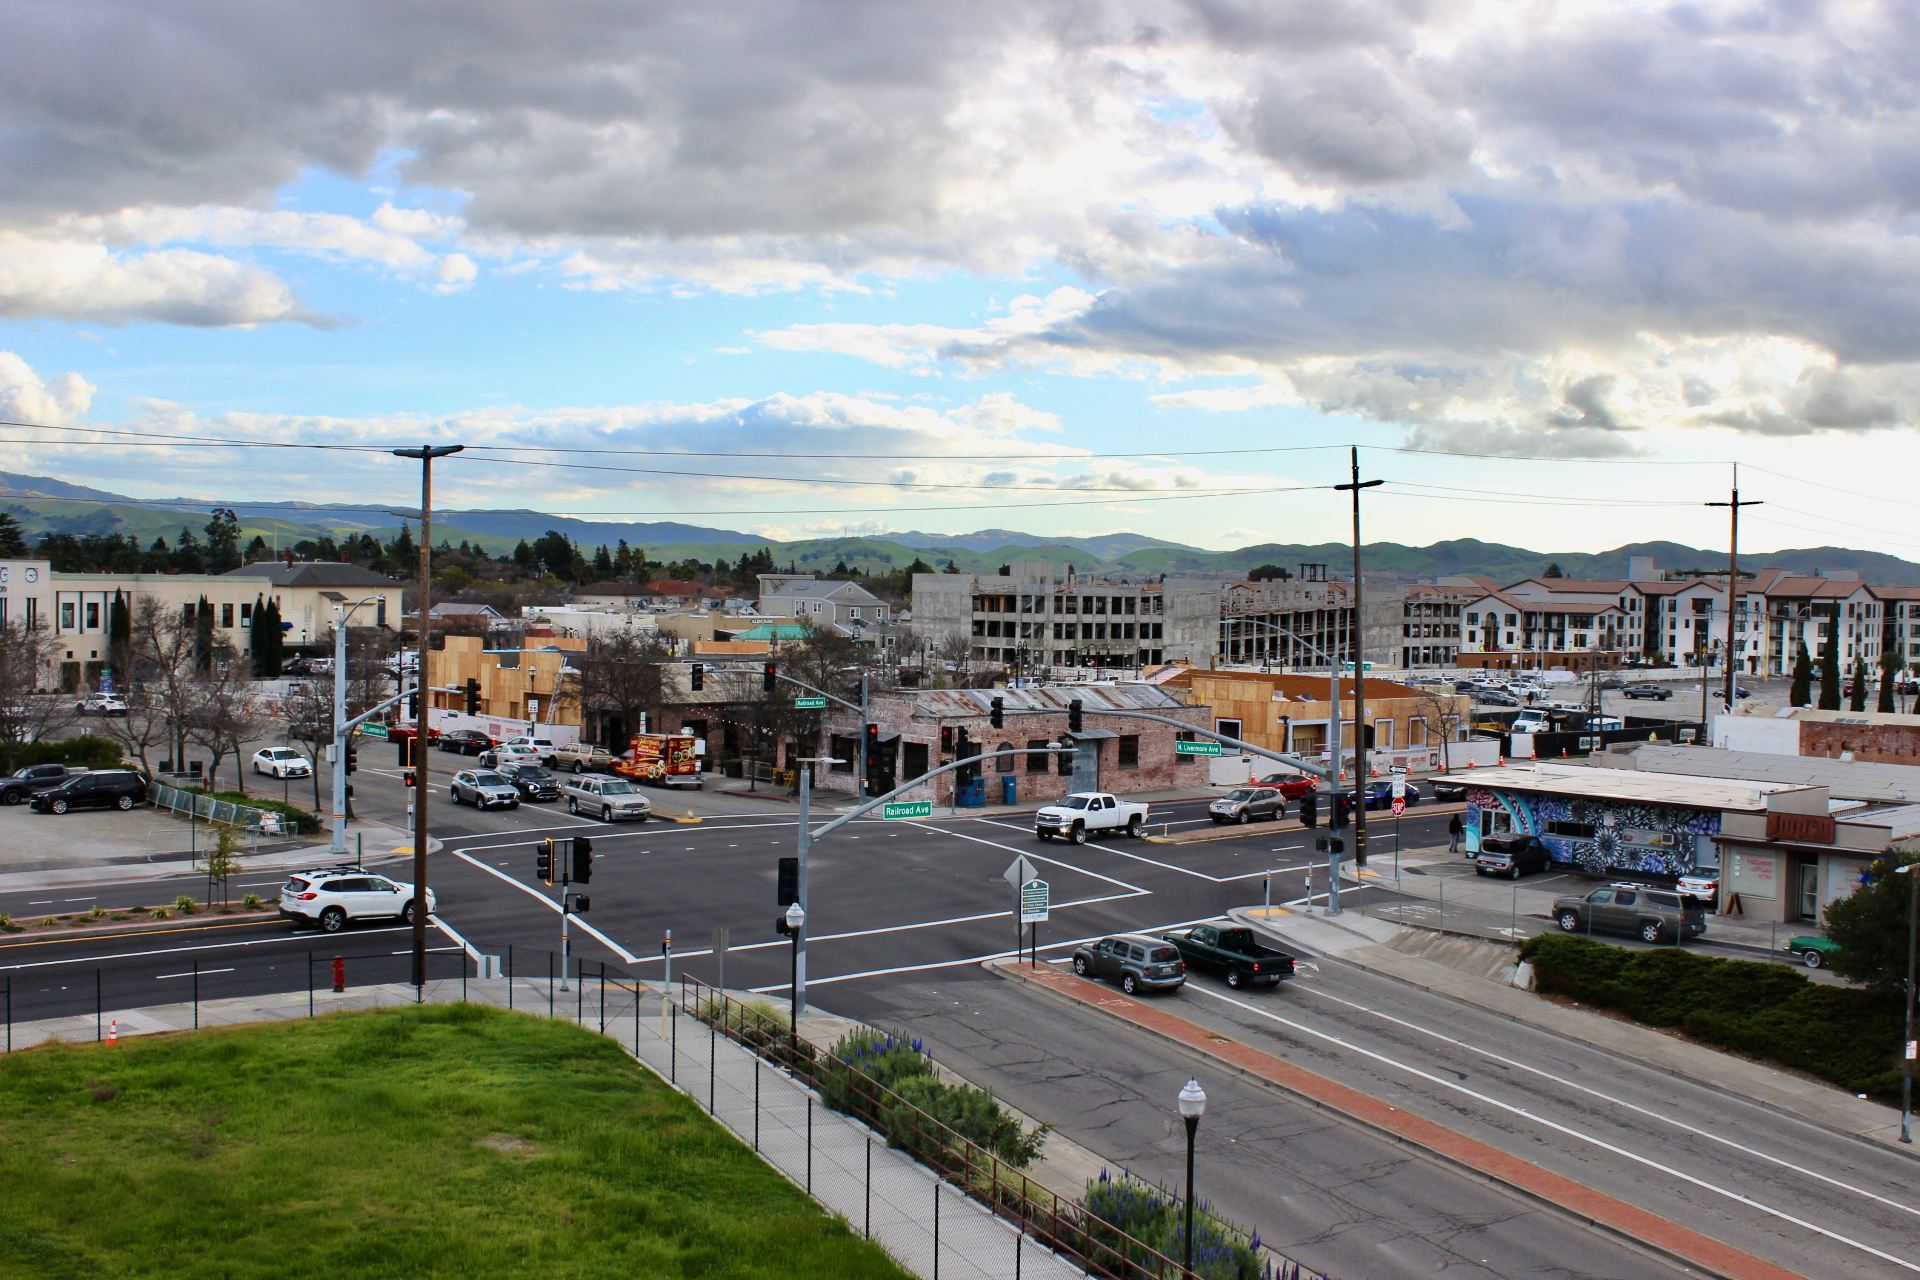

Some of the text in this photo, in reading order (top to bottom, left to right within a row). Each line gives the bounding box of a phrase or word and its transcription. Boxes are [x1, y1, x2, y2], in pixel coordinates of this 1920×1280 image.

[1183, 744, 1208, 753] Livermore
[1208, 745, 1219, 753] Ave
[886, 805, 929, 816] Railroad Ave
[1392, 802, 1404, 812] STOP
